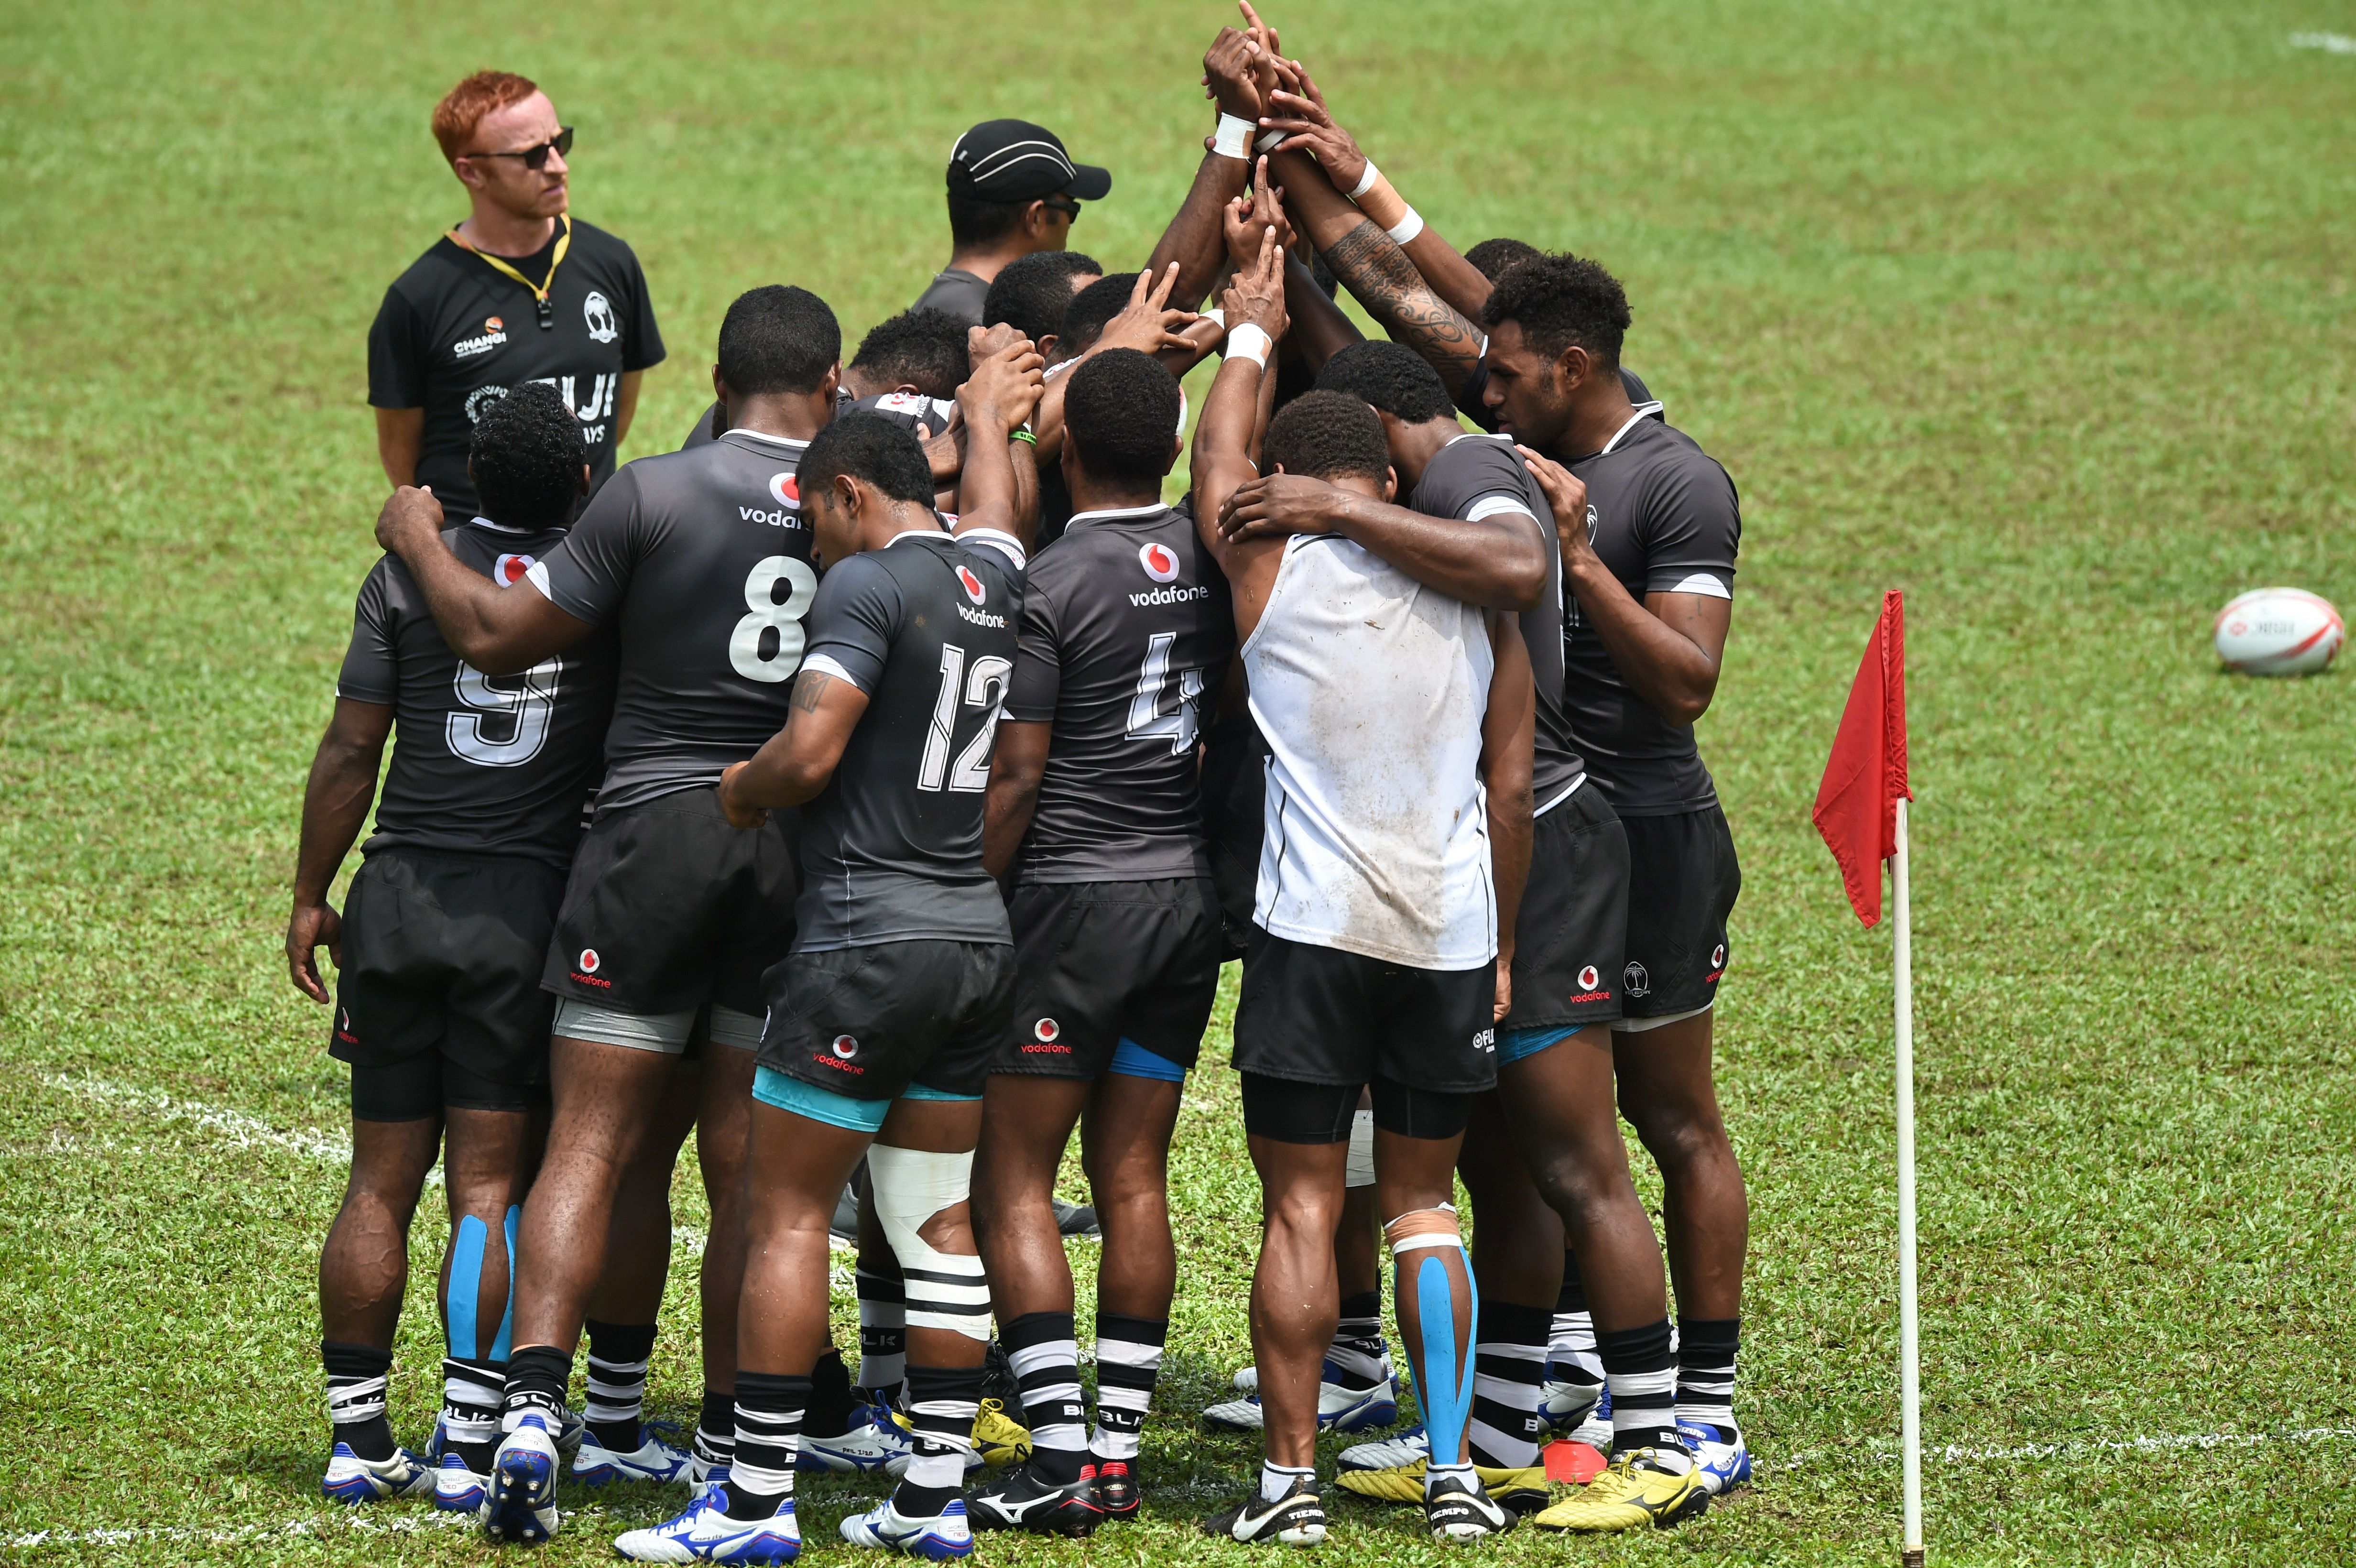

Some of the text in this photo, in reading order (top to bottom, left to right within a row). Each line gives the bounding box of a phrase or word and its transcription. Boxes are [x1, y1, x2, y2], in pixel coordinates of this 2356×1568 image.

[454, 332, 507, 353] CHANGI
[526, 372, 617, 421] IJI
[1129, 586, 1209, 607] vodafone
[729, 555, 817, 683] 8
[956, 601, 1004, 628] vodafone
[1124, 632, 1204, 757] 4
[445, 654, 563, 767] 9
[917, 642, 1013, 793] 12
[570, 971, 611, 989] vodafone
[1570, 990, 1610, 1003] vodafone
[1021, 1043, 1072, 1054] vodafone
[813, 1052, 864, 1075] vodafone
[1288, 1509, 1325, 1520] TIEMP
[1430, 1507, 1469, 1521] TIEMPO
